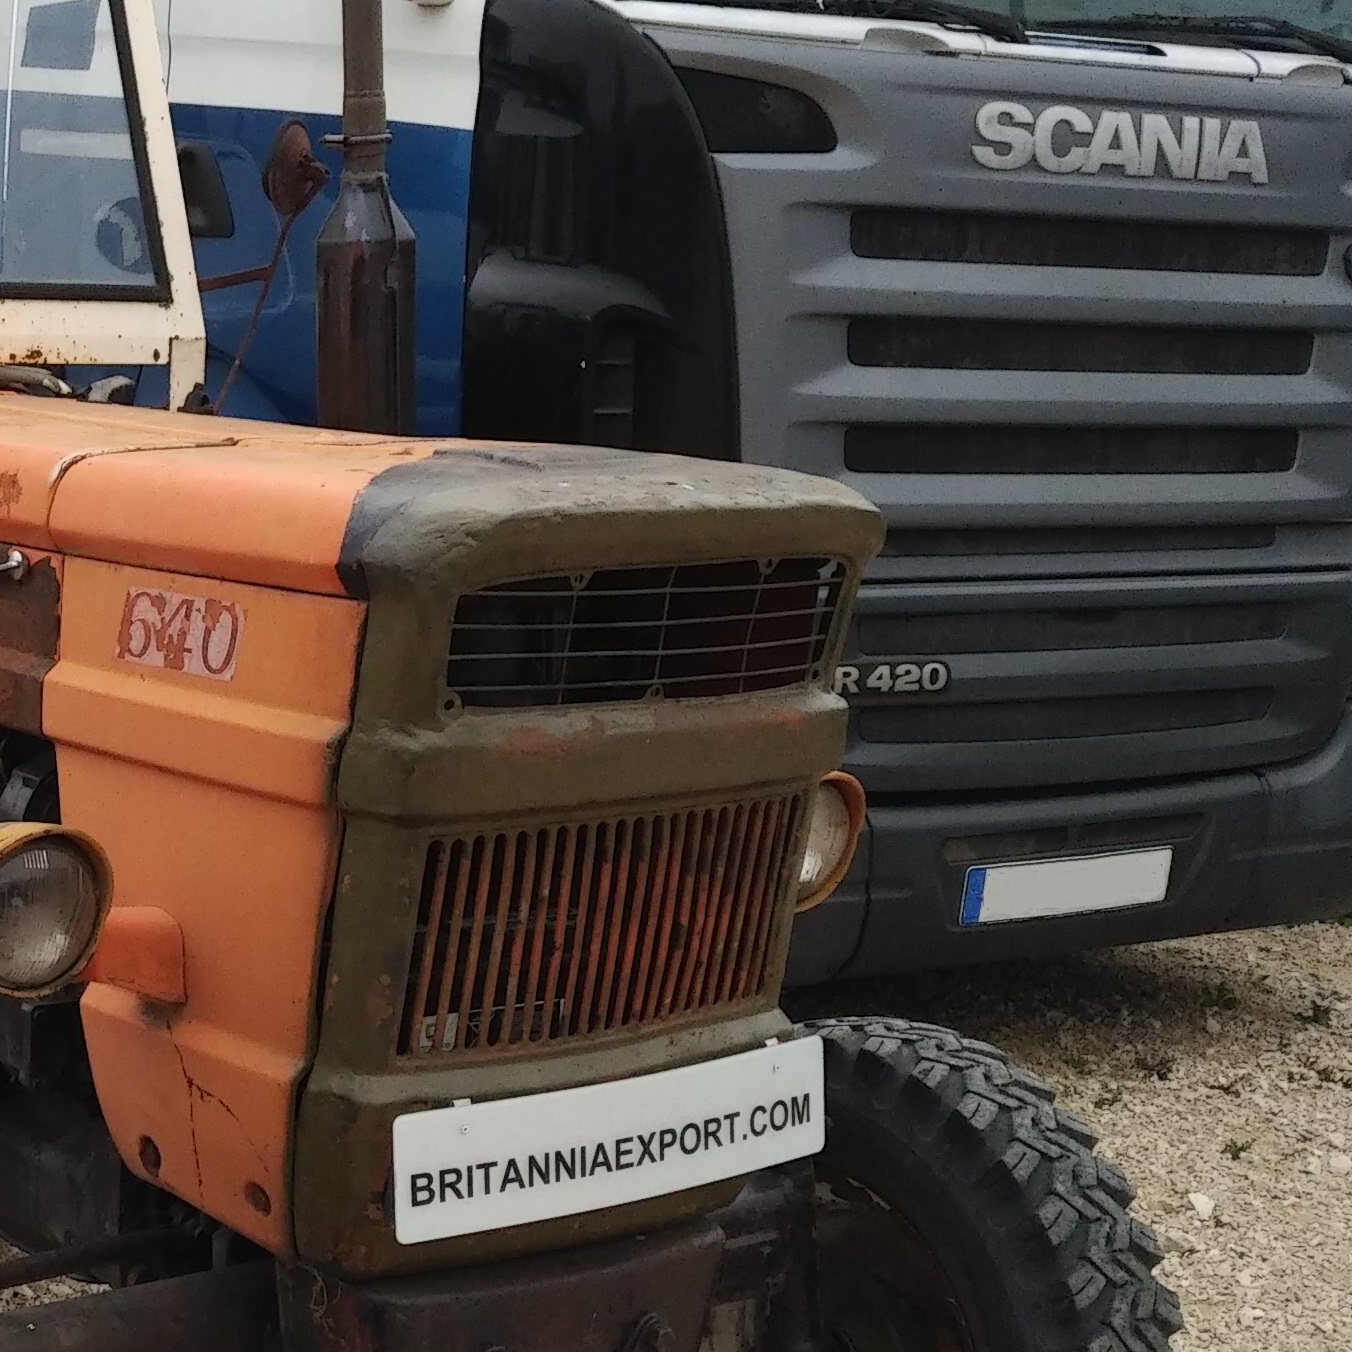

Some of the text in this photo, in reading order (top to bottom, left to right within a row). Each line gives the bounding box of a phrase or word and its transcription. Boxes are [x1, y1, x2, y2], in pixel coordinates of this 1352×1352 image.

[970, 100, 1269, 184] SCANIA
[119, 591, 239, 675] 640
[833, 662, 949, 694] R 420
[410, 1093, 812, 1208] BRITANNIAEXPORT.COM
